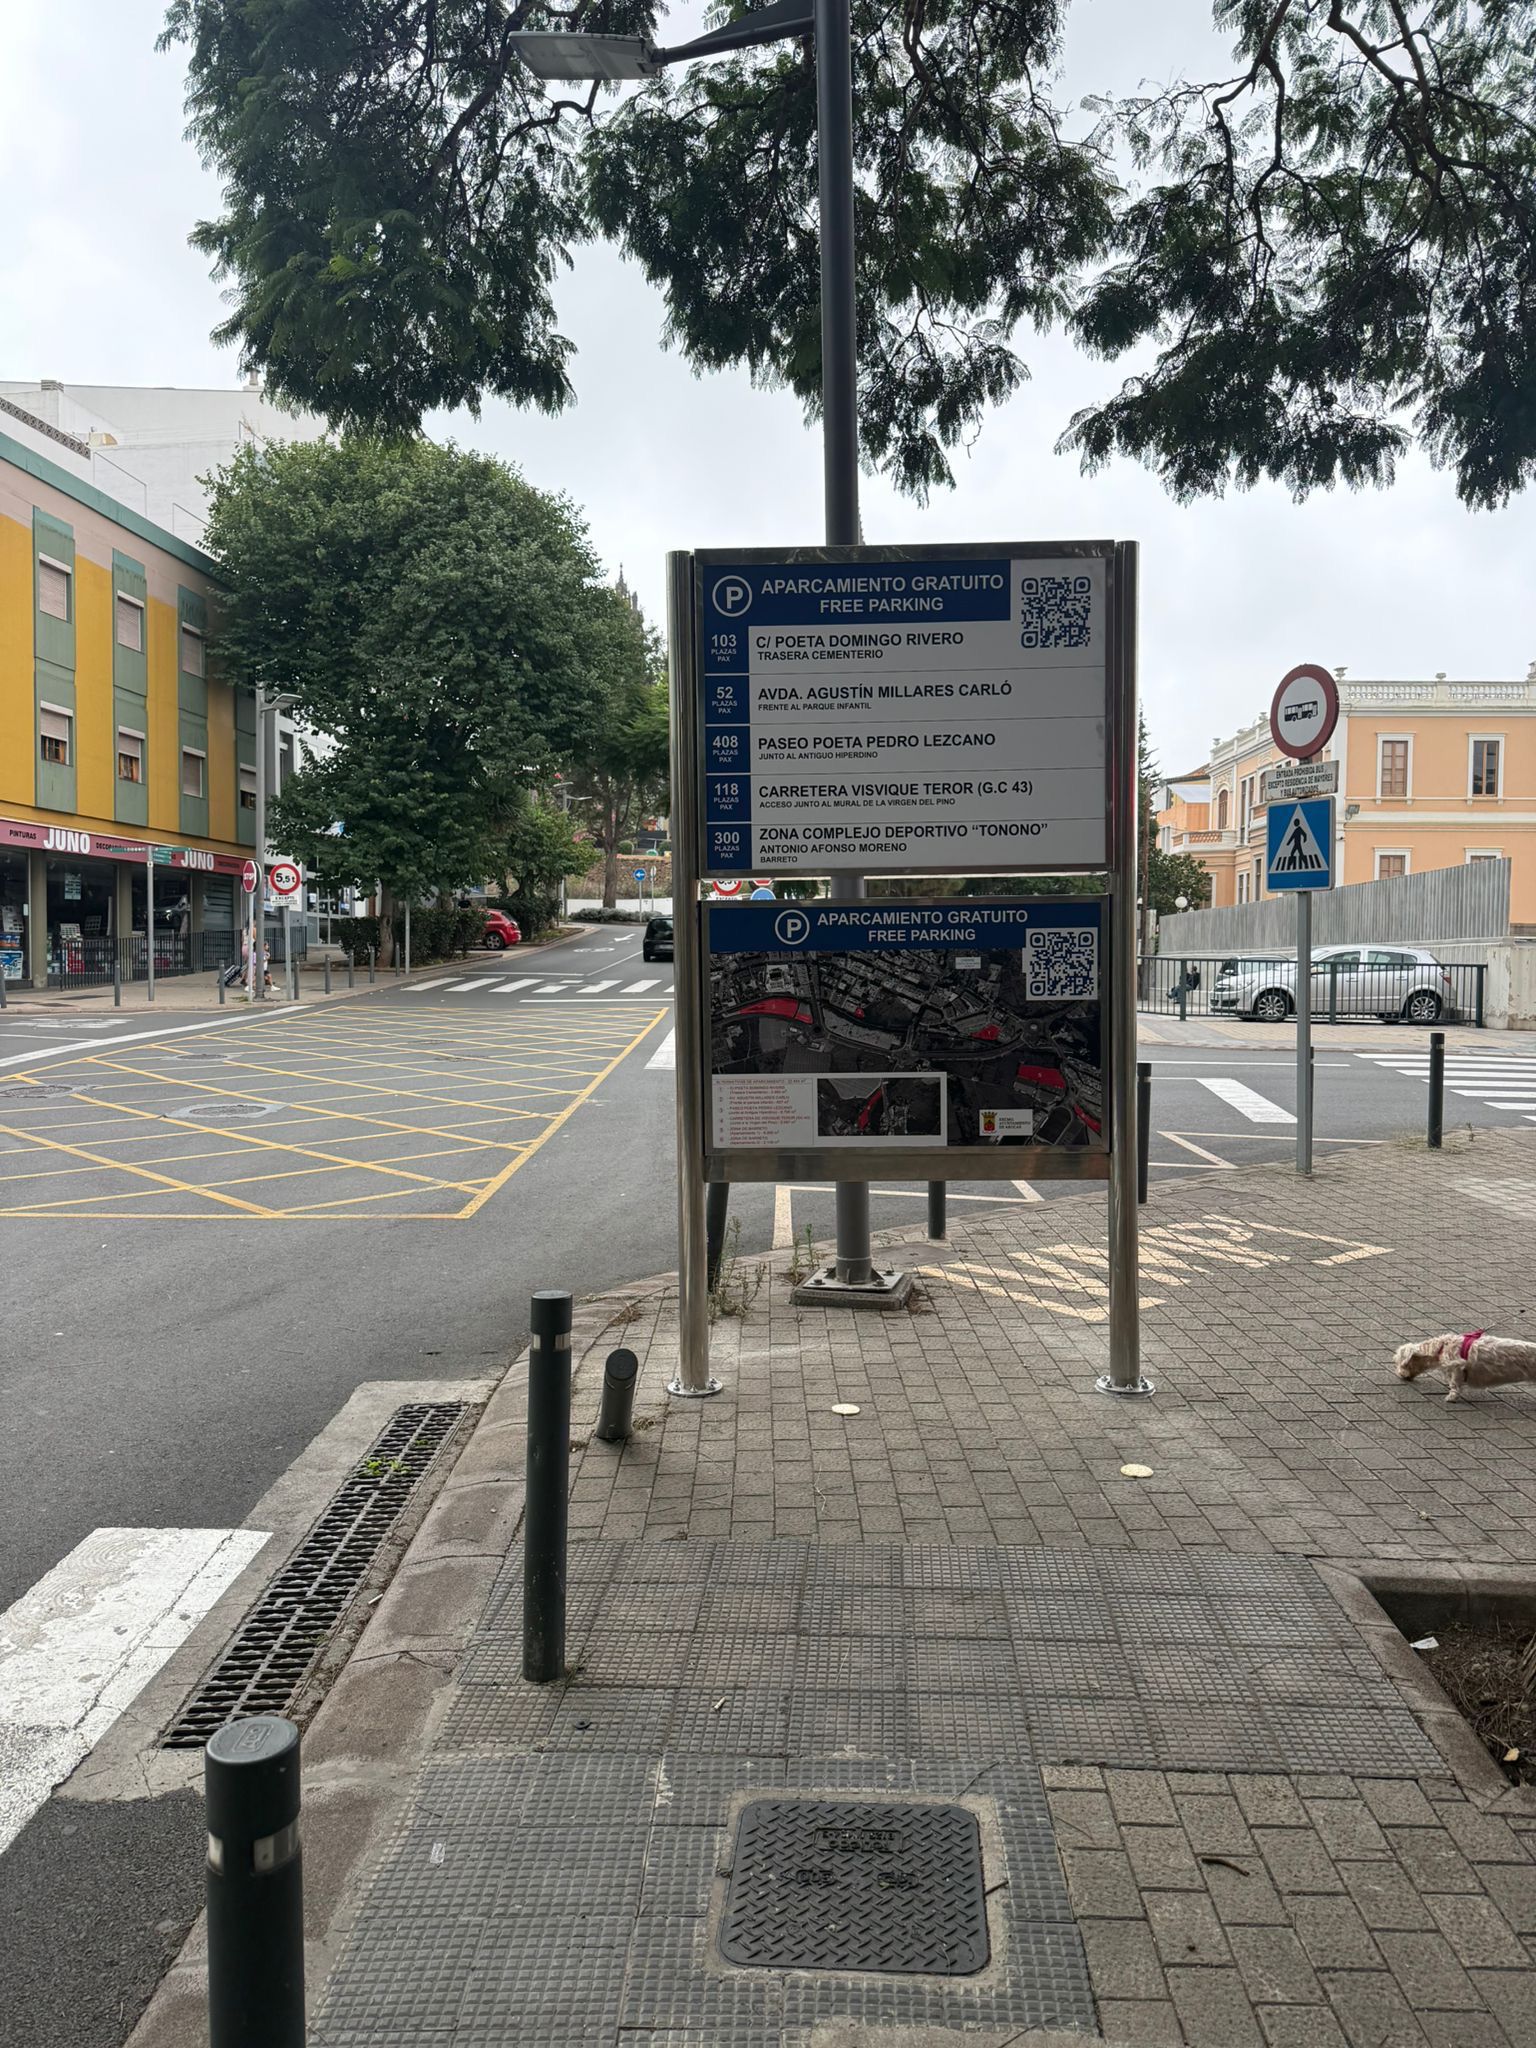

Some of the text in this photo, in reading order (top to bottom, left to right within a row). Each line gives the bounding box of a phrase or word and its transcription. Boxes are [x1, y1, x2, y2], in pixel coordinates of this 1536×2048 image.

[761, 575, 1004, 594] APARCAMIENTO GRATUITO
[726, 587, 743, 609] P
[819, 597, 944, 614] FREE PARKING
[711, 633, 737, 648] 103
[756, 632, 964, 649] C/ POETA DOMINGO RIVERO
[757, 649, 884, 661] TRASERA CEMENTERIO
[716, 686, 734, 700] 52
[758, 680, 1012, 700] AVDA. AGUSTÍN MILLARES CARLÓ
[802, 703, 835, 711] PARQUE
[836, 702, 872, 710] INFANTIL
[712, 735, 739, 749] 408
[758, 734, 996, 750] PASEO POETA PEDRO LEZCANO
[835, 751, 878, 759] HIPERDINO
[714, 784, 739, 797] 118
[759, 780, 1033, 798] CARRETERA VISVIQUE TEROR (G.C 43)
[714, 832, 740, 845] 300
[759, 823, 1048, 840] ZONA COMPLEJO DEPORTIVO “TONONO”
[9, 830, 36, 840] PINTURAS
[43, 828, 90, 854] JUNO
[760, 842, 907, 854] ANTONIO AFONSO MORENO
[180, 850, 214, 870] JUNO
[244, 872, 254, 880] STOP
[817, 910, 1028, 926] APARCAMIENTO GRATUITO
[787, 919, 802, 938] P
[868, 928, 976, 942] FREE PARKING
